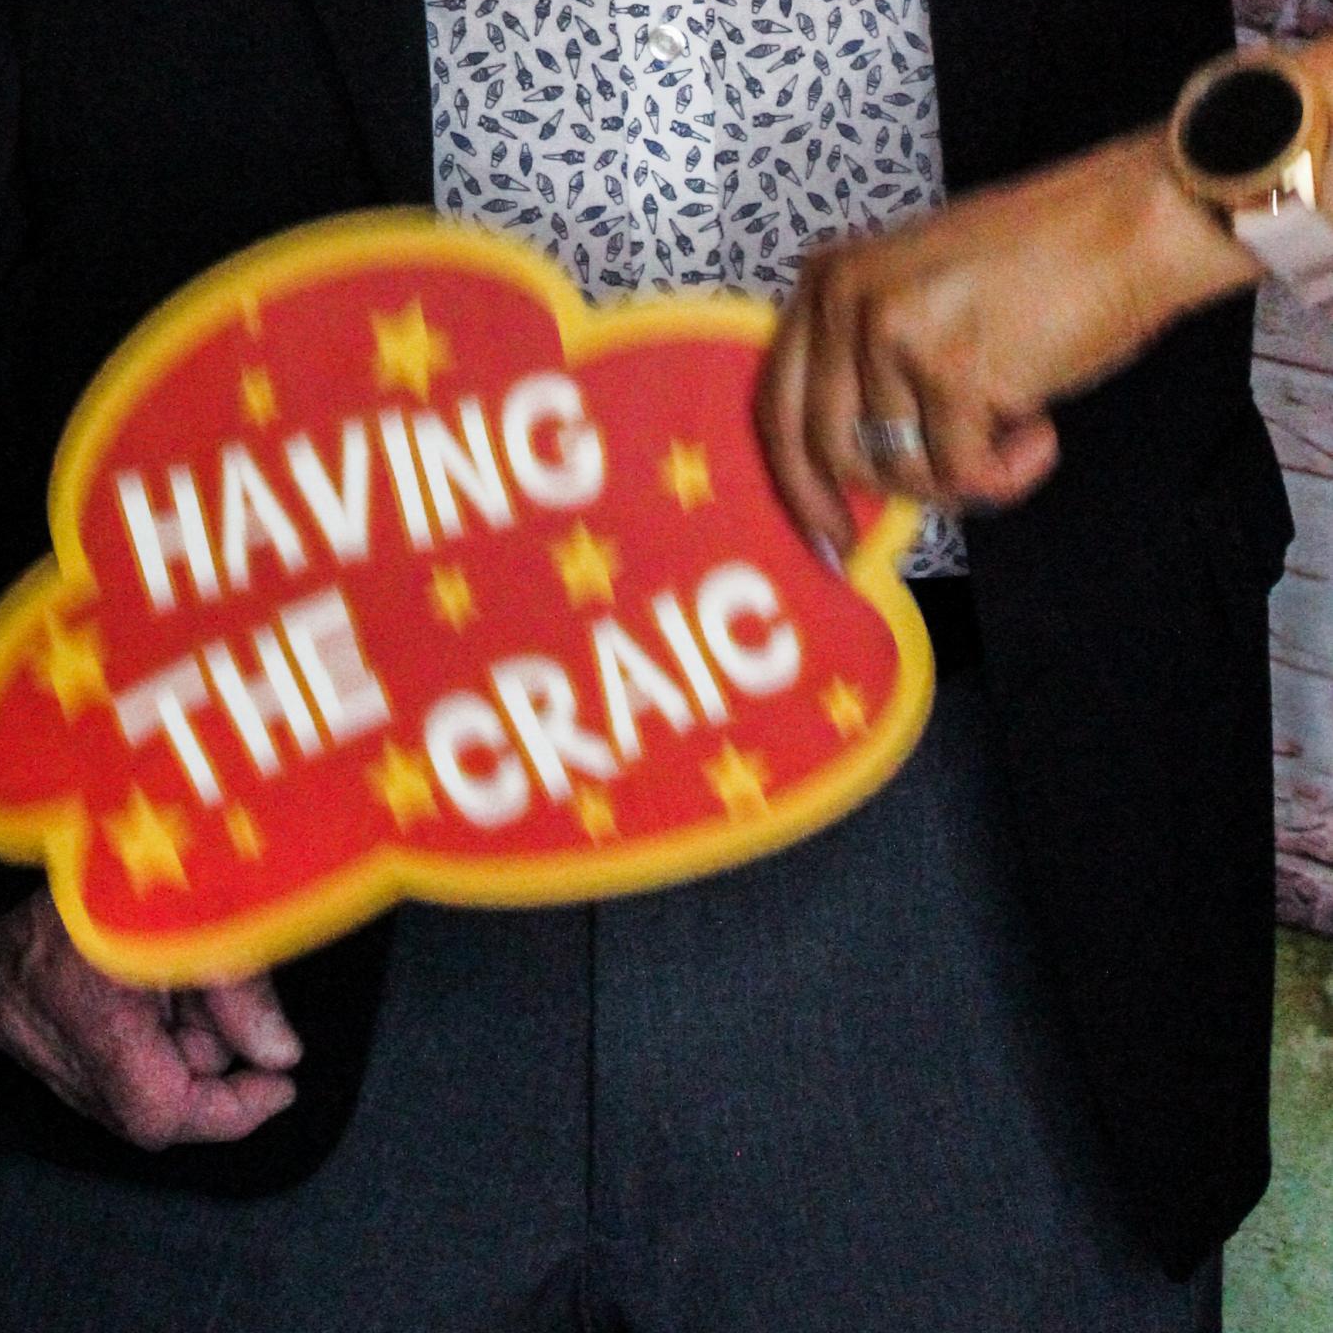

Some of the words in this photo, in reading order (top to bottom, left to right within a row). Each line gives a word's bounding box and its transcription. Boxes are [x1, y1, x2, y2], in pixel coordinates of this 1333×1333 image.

[115, 371, 605, 613] HAVING
[113, 586, 391, 808] THE
[421, 562, 803, 828] CRAIC
